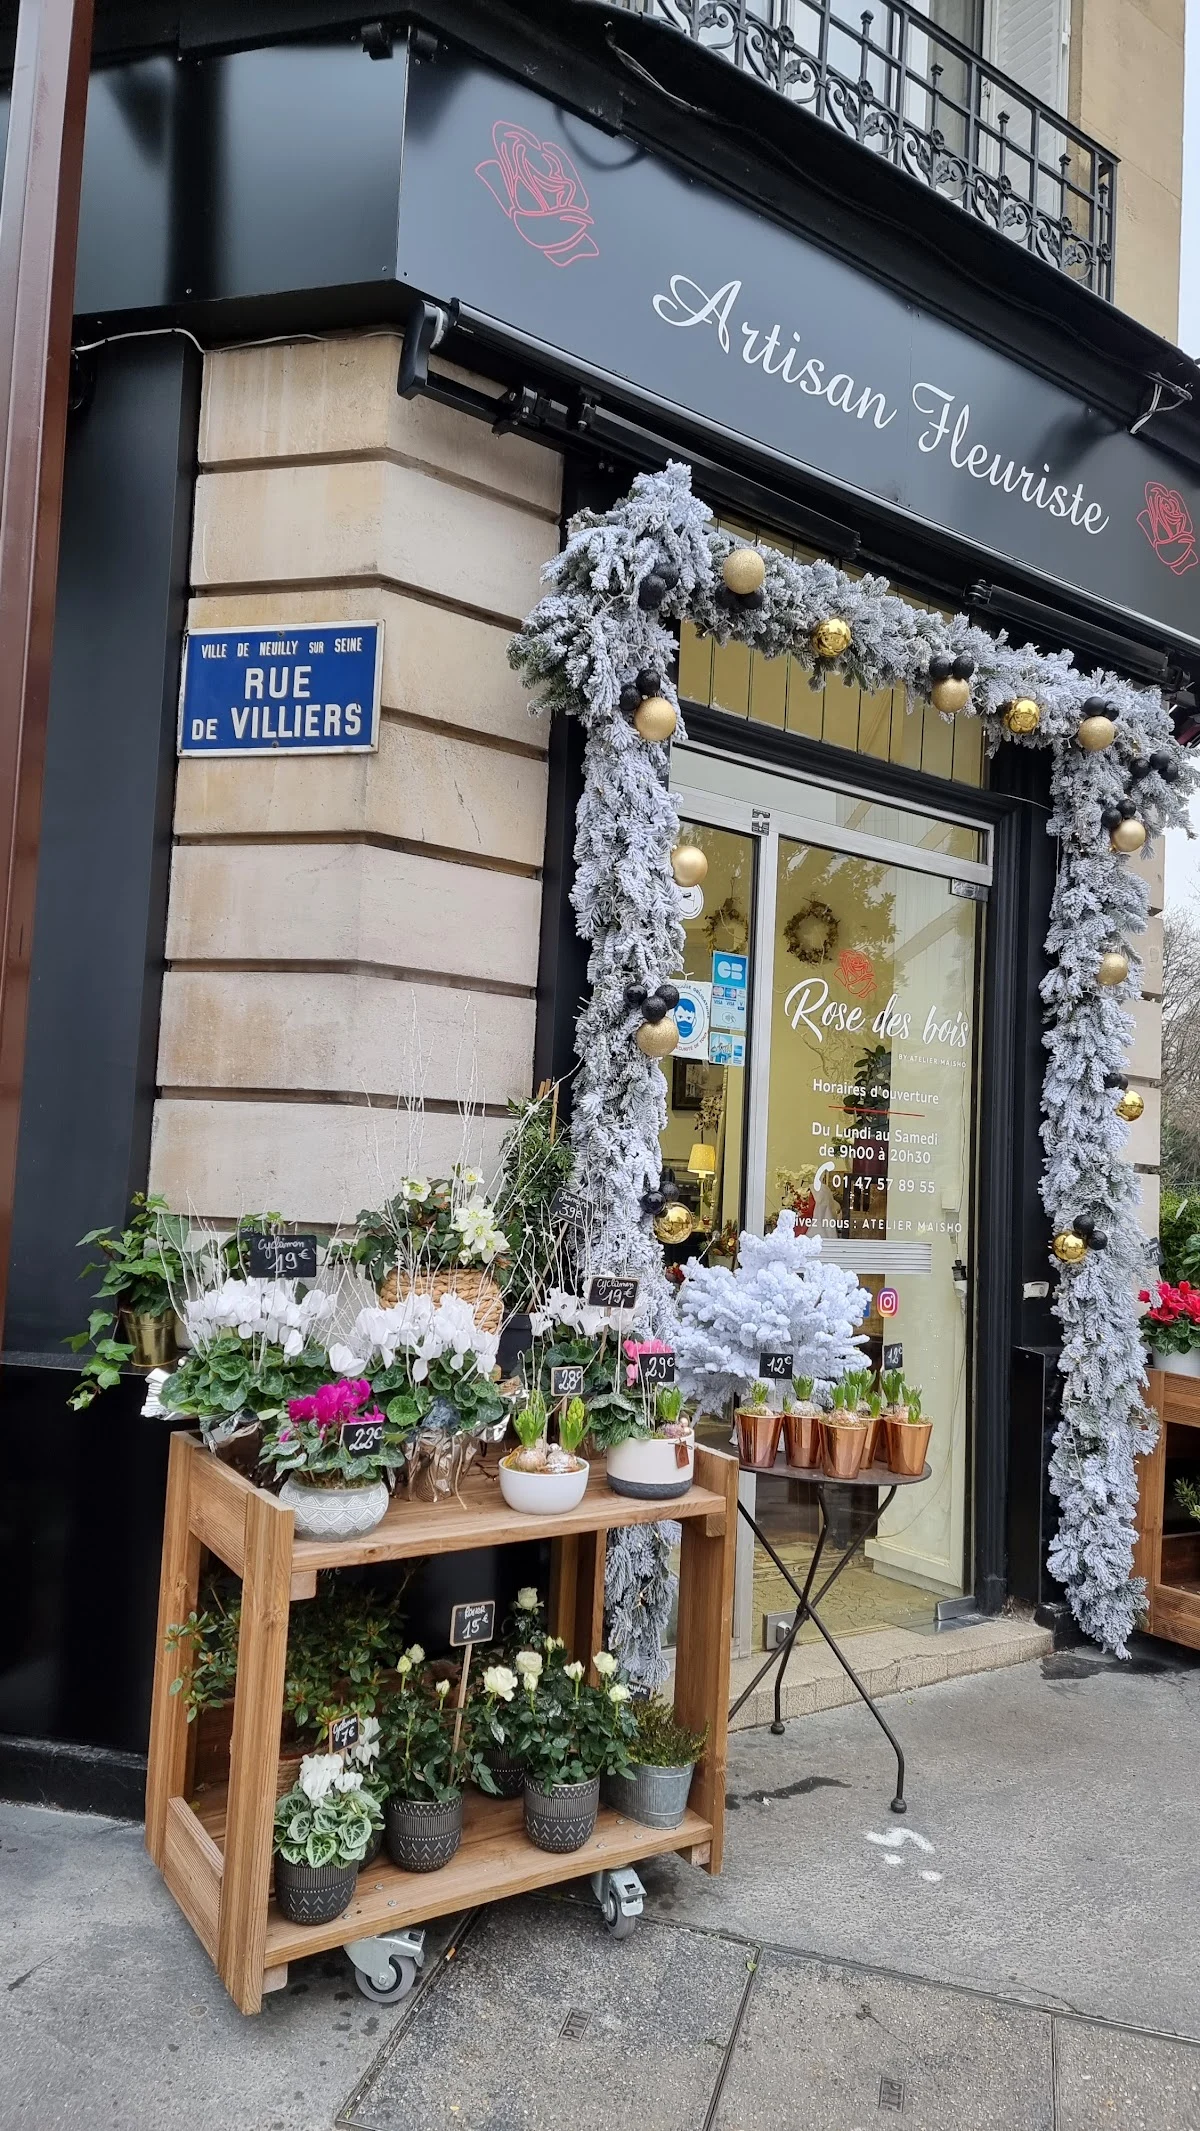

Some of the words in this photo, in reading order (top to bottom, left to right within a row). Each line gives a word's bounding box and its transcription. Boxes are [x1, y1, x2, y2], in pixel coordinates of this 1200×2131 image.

[652, 274, 898, 429] Artisan
[912, 382, 1109, 535] Fleuriste
[201, 643, 228, 659] VILLE
[237, 642, 250, 657] DE
[259, 640, 298, 656] NEUILLY
[308, 641, 325, 654] SUR
[334, 637, 363, 652] SEINE
[244, 665, 312, 700] RUE
[191, 718, 218, 740] DE
[230, 703, 362, 739] VILLIERS
[784, 977, 865, 1043] Rose
[872, 993, 912, 1040] des
[922, 1004, 969, 1048] bois
[909, 1055, 938, 1065] ATELIER
[940, 1058, 967, 1068] MAISHO
[813, 1078, 867, 1097] Horaires
[870, 1085, 939, 1105] d'ouverture
[812, 1121, 830, 1137] Du
[835, 1123, 871, 1140] Lundi
[875, 1130, 890, 1142] au
[895, 1130, 938, 1146] Samedi
[819, 1143, 835, 1157] de
[839, 1145, 874, 1160] 9h00
[878, 1147, 885, 1161] à
[890, 1149, 931, 1164] 20h30
[832, 1174, 849, 1189] 01
[854, 1176, 872, 1190] 47
[876, 1178, 893, 1191] 57
[898, 1179, 915, 1193] 89
[919, 1180, 935, 1194] 55
[795, 1215, 818, 1228] ivez
[822, 1218, 850, 1229] nous
[862, 1218, 912, 1231] ATELIER
[917, 1221, 962, 1233] MAISHO
